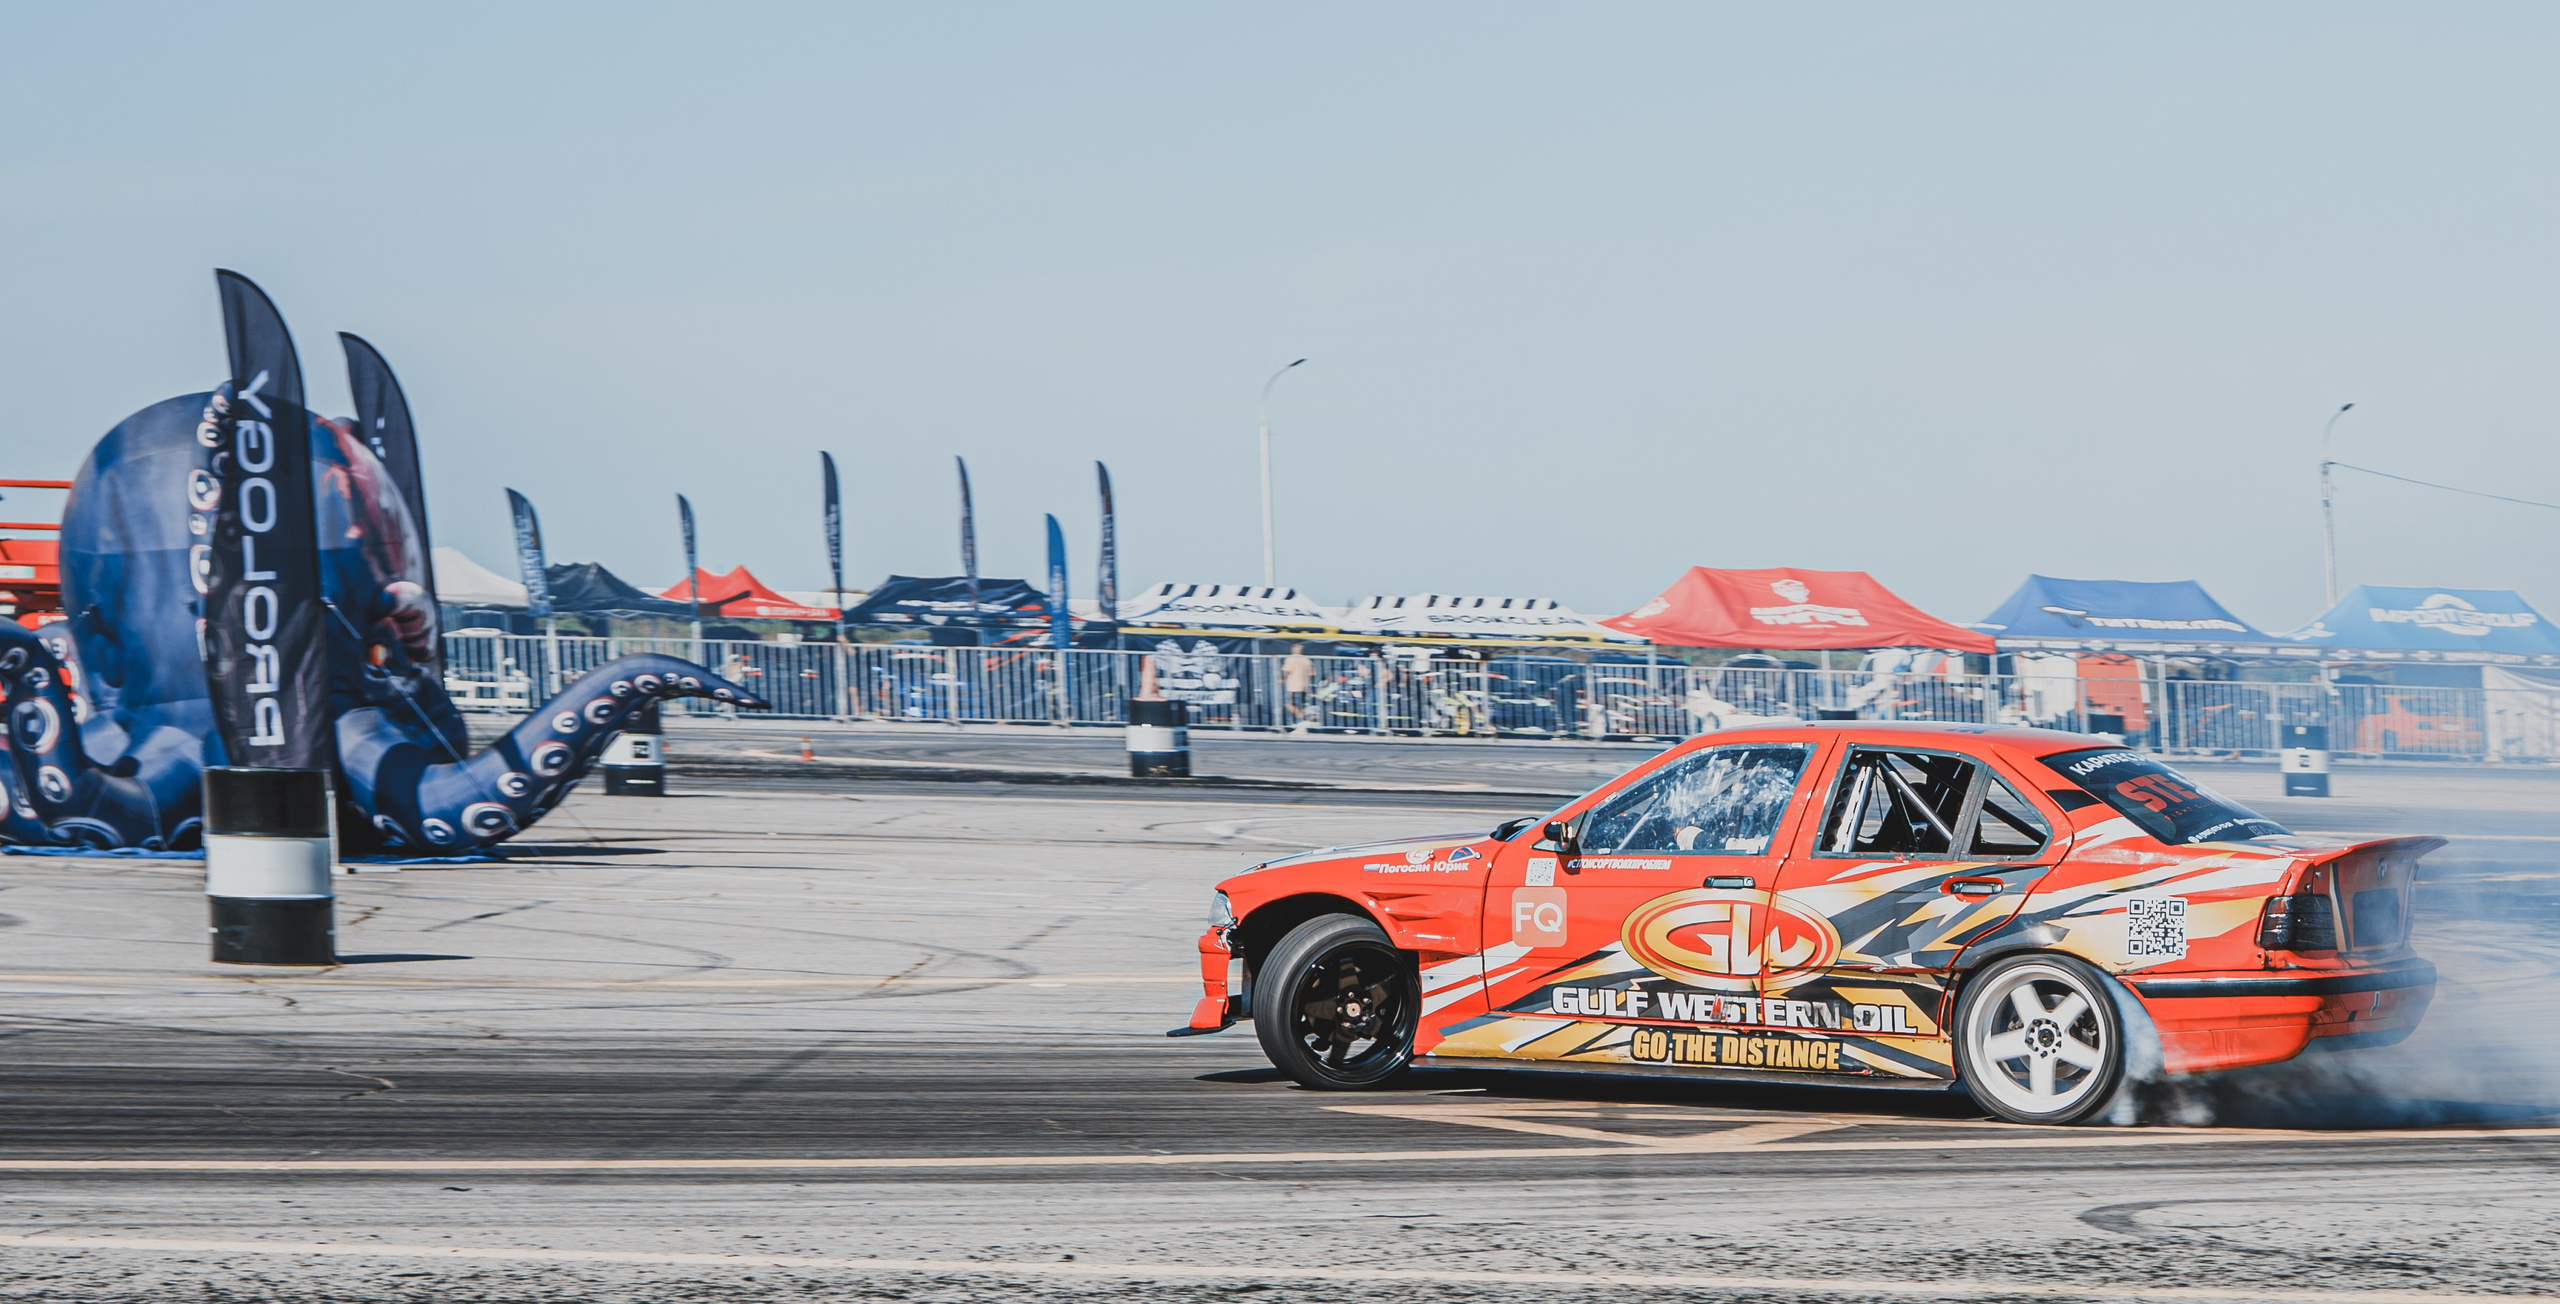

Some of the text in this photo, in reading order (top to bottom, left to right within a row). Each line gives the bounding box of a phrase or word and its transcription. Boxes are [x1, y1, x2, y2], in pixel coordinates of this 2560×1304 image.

[1427, 613, 1587, 627] BROOKCLEAN
[1379, 861, 1469, 874] Погосян Юрик
[1515, 901, 1563, 933] FQ
[1644, 903, 1816, 975] GW
[1551, 986, 1918, 1034] GULF WESTERN OIL
[1633, 1030, 1841, 1070] GO THE DISTANCE
